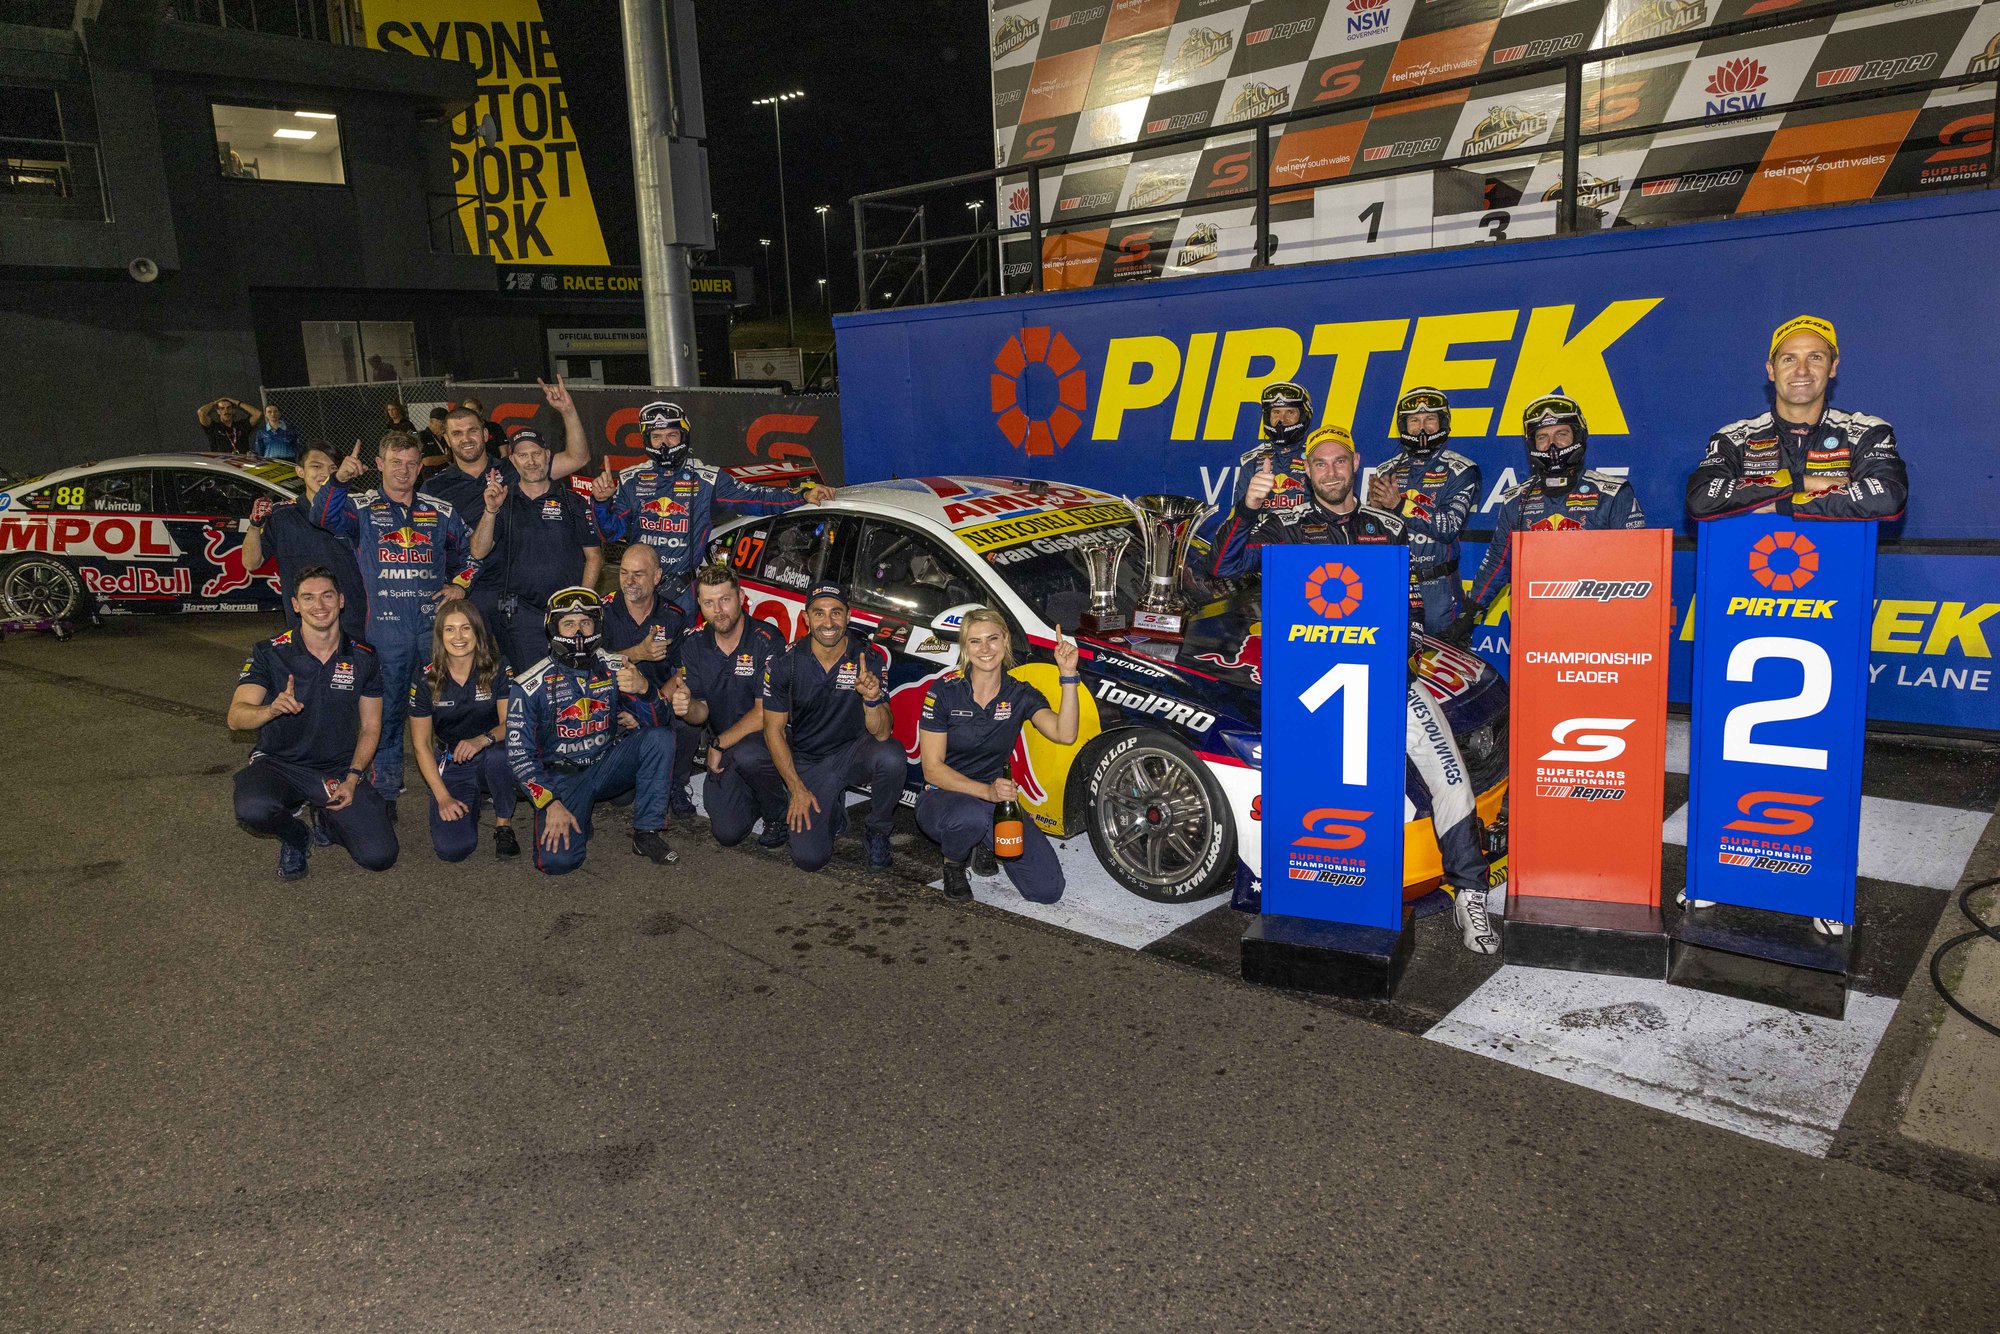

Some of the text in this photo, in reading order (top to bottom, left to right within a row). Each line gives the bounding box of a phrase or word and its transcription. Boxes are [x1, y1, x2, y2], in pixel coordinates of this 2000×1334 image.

[1070, 6, 1105, 25] Repco
[1347, 9, 1390, 34] NSW
[1273, 18, 1315, 39] Repco
[1347, 27, 1389, 41] GOVERNMENT
[1526, 33, 1583, 57] Repco
[1392, 58, 1477, 82] feel new south wales
[1860, 53, 1938, 80] Repco
[1169, 111, 1207, 129] Repco
[1392, 137, 1441, 158] Repco
[1276, 154, 1350, 174] feel new south wales
[1764, 154, 1885, 178] feel new south wales
[1677, 170, 1743, 193] Repco
[1079, 192, 1114, 207] Repco
[1010, 213, 1030, 227] NS
[1358, 202, 1384, 243] 1
[1066, 259, 1080, 267] south
[1114, 263, 1152, 272] SUPERCARS
[1113, 269, 1152, 277] CHAMPIONSHIP
[563, 276, 604, 291] RACE
[559, 333, 593, 341] OFFICIAL
[1776, 319, 1831, 339] DUNLOP
[1092, 297, 1664, 440] PIRTEK
[1308, 428, 1350, 444] DUNLOP
[1559, 443, 1582, 456] AMPOL
[57, 487, 85, 506] 88
[1263, 494, 1304, 509] ed Bull
[639, 516, 688, 533] Red Bull
[962, 513, 1079, 548] NATIONAL
[1384, 519, 1400, 532] OMP
[639, 534, 688, 548] AMPOL
[379, 548, 433, 563] Red Bull
[734, 536, 765, 569] 97
[995, 548, 1039, 565] van
[79, 567, 192, 594] Red Bull
[378, 569, 438, 580] AMPOL
[764, 565, 777, 580] van
[1576, 579, 1652, 602] Repco
[182, 602, 258, 613] Harvey Norman
[1726, 596, 1838, 619] PIRTEK
[553, 636, 576, 644] AMPOL
[1288, 624, 1380, 645] PIRTEK
[1106, 656, 1166, 678] DUNLOP
[1526, 651, 1653, 667] CHAMPIONSHIP
[525, 679, 539, 691] OMP
[1557, 671, 1619, 684] LEADER
[1897, 667, 1992, 692] LANE
[1095, 679, 1216, 732] ToolPRO
[1723, 636, 1832, 770] 2
[557, 721, 586, 738] Red
[1298, 663, 1369, 786] 1
[1407, 688, 1463, 786] GIVES YOU WINGS
[1089, 737, 1138, 796] DUNLOP
[1537, 767, 1626, 779] SUPERCARS
[1536, 776, 1626, 786] CHAMPIONSHIP
[1570, 785, 1626, 802] Repco
[1035, 814, 1058, 826] Repco
[995, 836, 1023, 845] FOXTEL
[1720, 835, 1813, 855] SUPERCARS
[1175, 821, 1223, 897] SPORT MAXX
[1289, 852, 1367, 867] SUPERCARS
[1720, 844, 1812, 861] CHAMPIONSHIP
[1289, 860, 1367, 873] CHAMPIONSHIP
[1753, 856, 1812, 875] Repco
[1317, 869, 1367, 886] Repco
